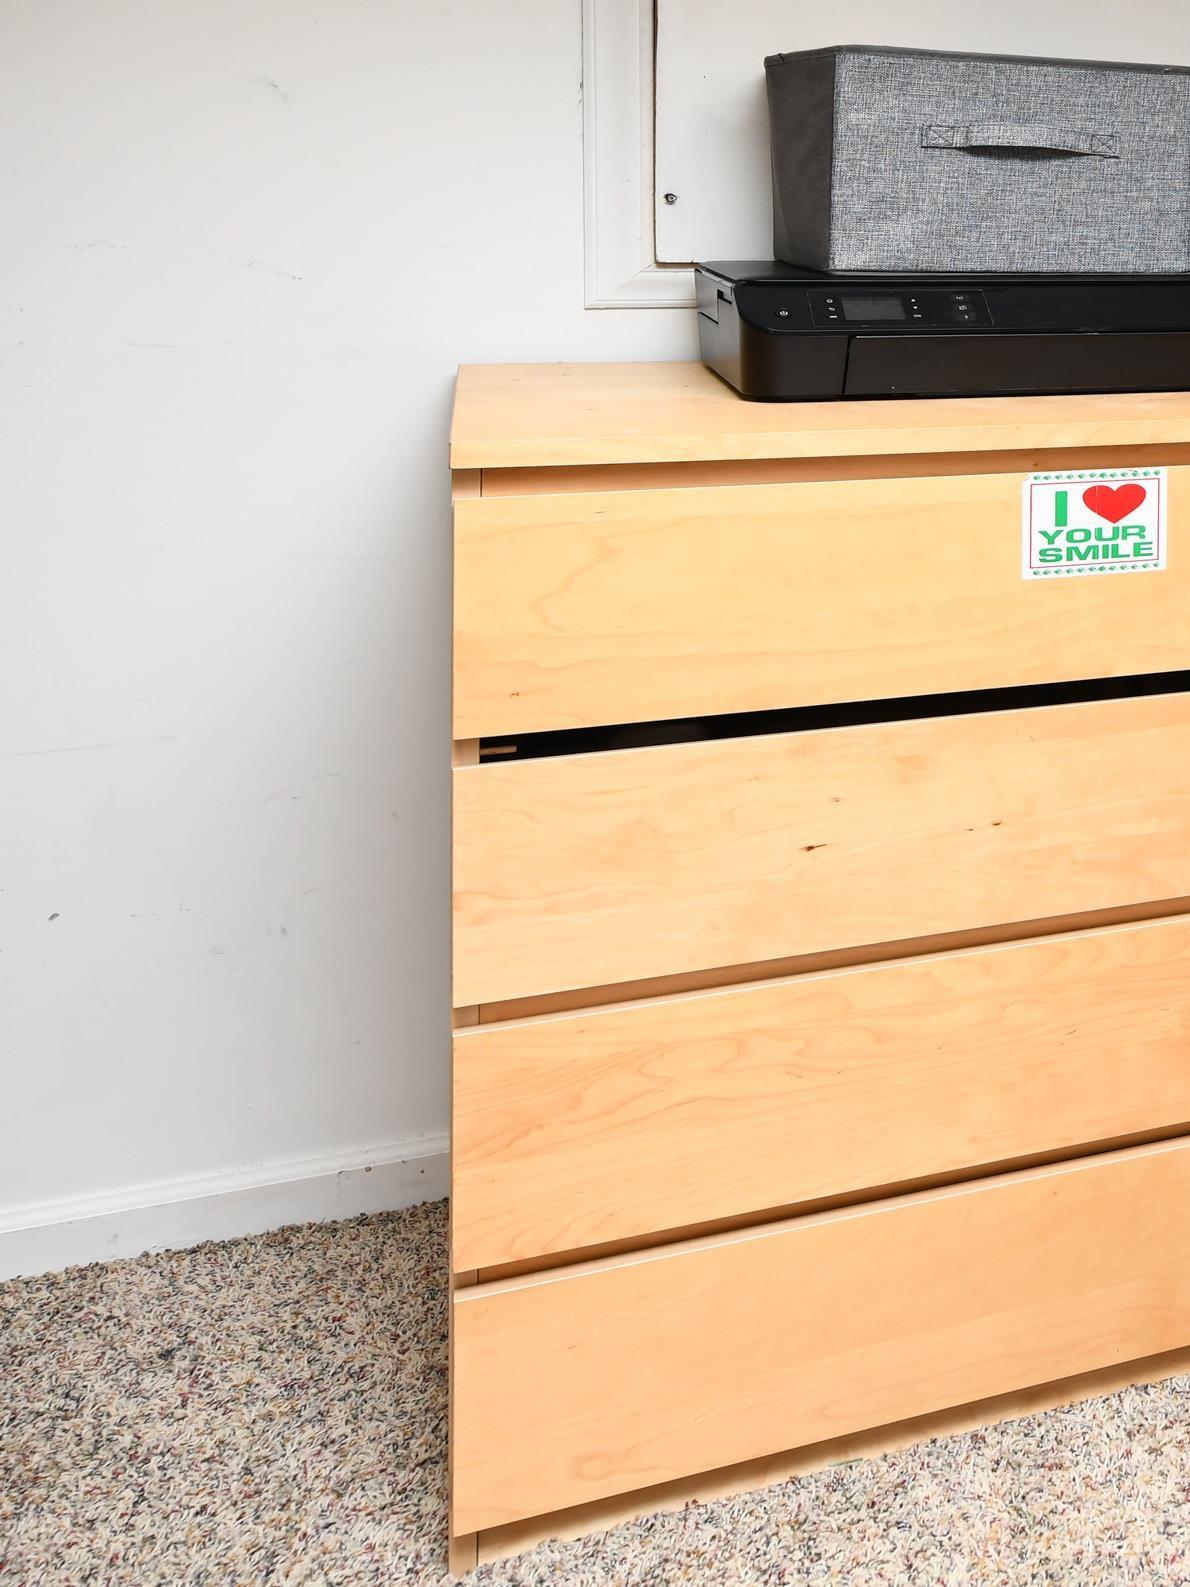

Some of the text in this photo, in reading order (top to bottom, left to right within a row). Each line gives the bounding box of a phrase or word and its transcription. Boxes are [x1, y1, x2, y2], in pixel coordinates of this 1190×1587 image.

[1055, 491, 1068, 527] I
[1038, 525, 1146, 545] YOUR
[1038, 541, 1153, 563] SMILE
